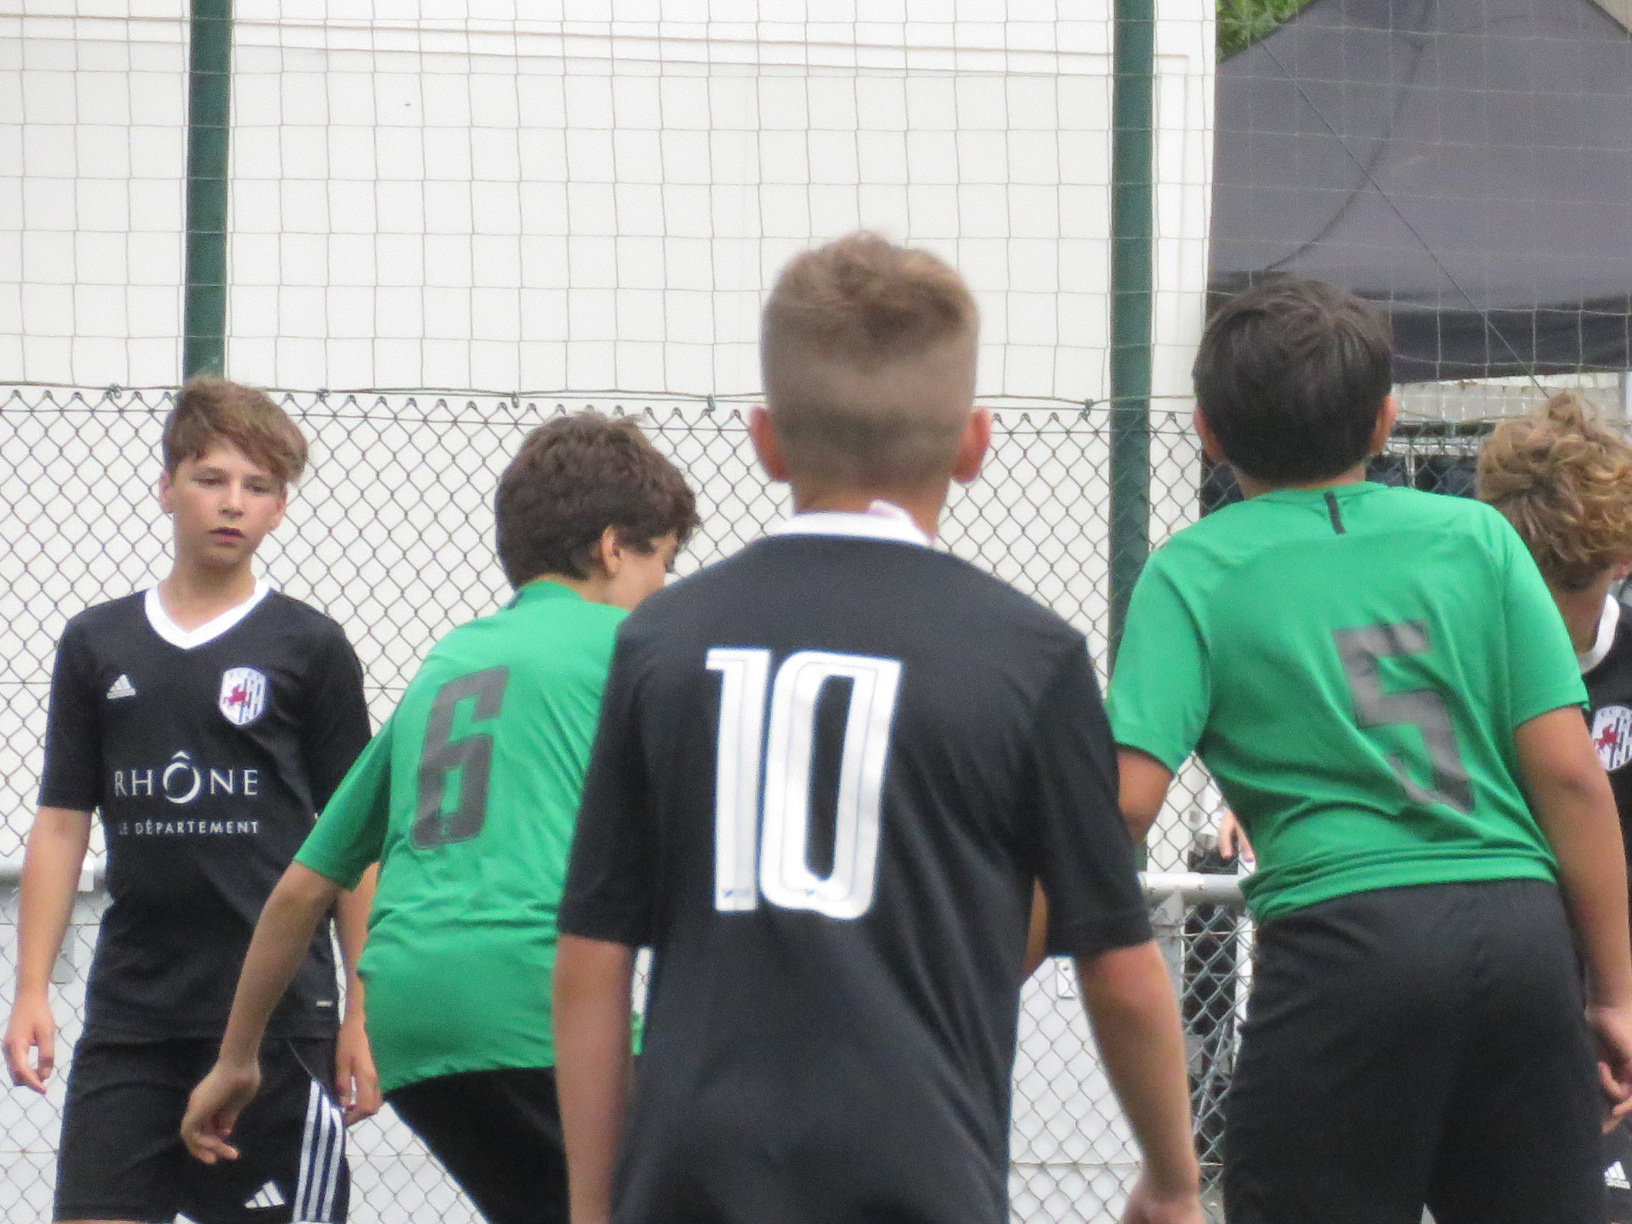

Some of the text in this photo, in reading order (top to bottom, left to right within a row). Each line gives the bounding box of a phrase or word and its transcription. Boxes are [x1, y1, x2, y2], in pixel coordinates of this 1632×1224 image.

[114, 751, 259, 804] RHÔNE
[411, 665, 510, 849] 6
[705, 648, 902, 919] 10
[1332, 619, 1476, 815] 5
[135, 819, 259, 836] DÉPARTEMENT
